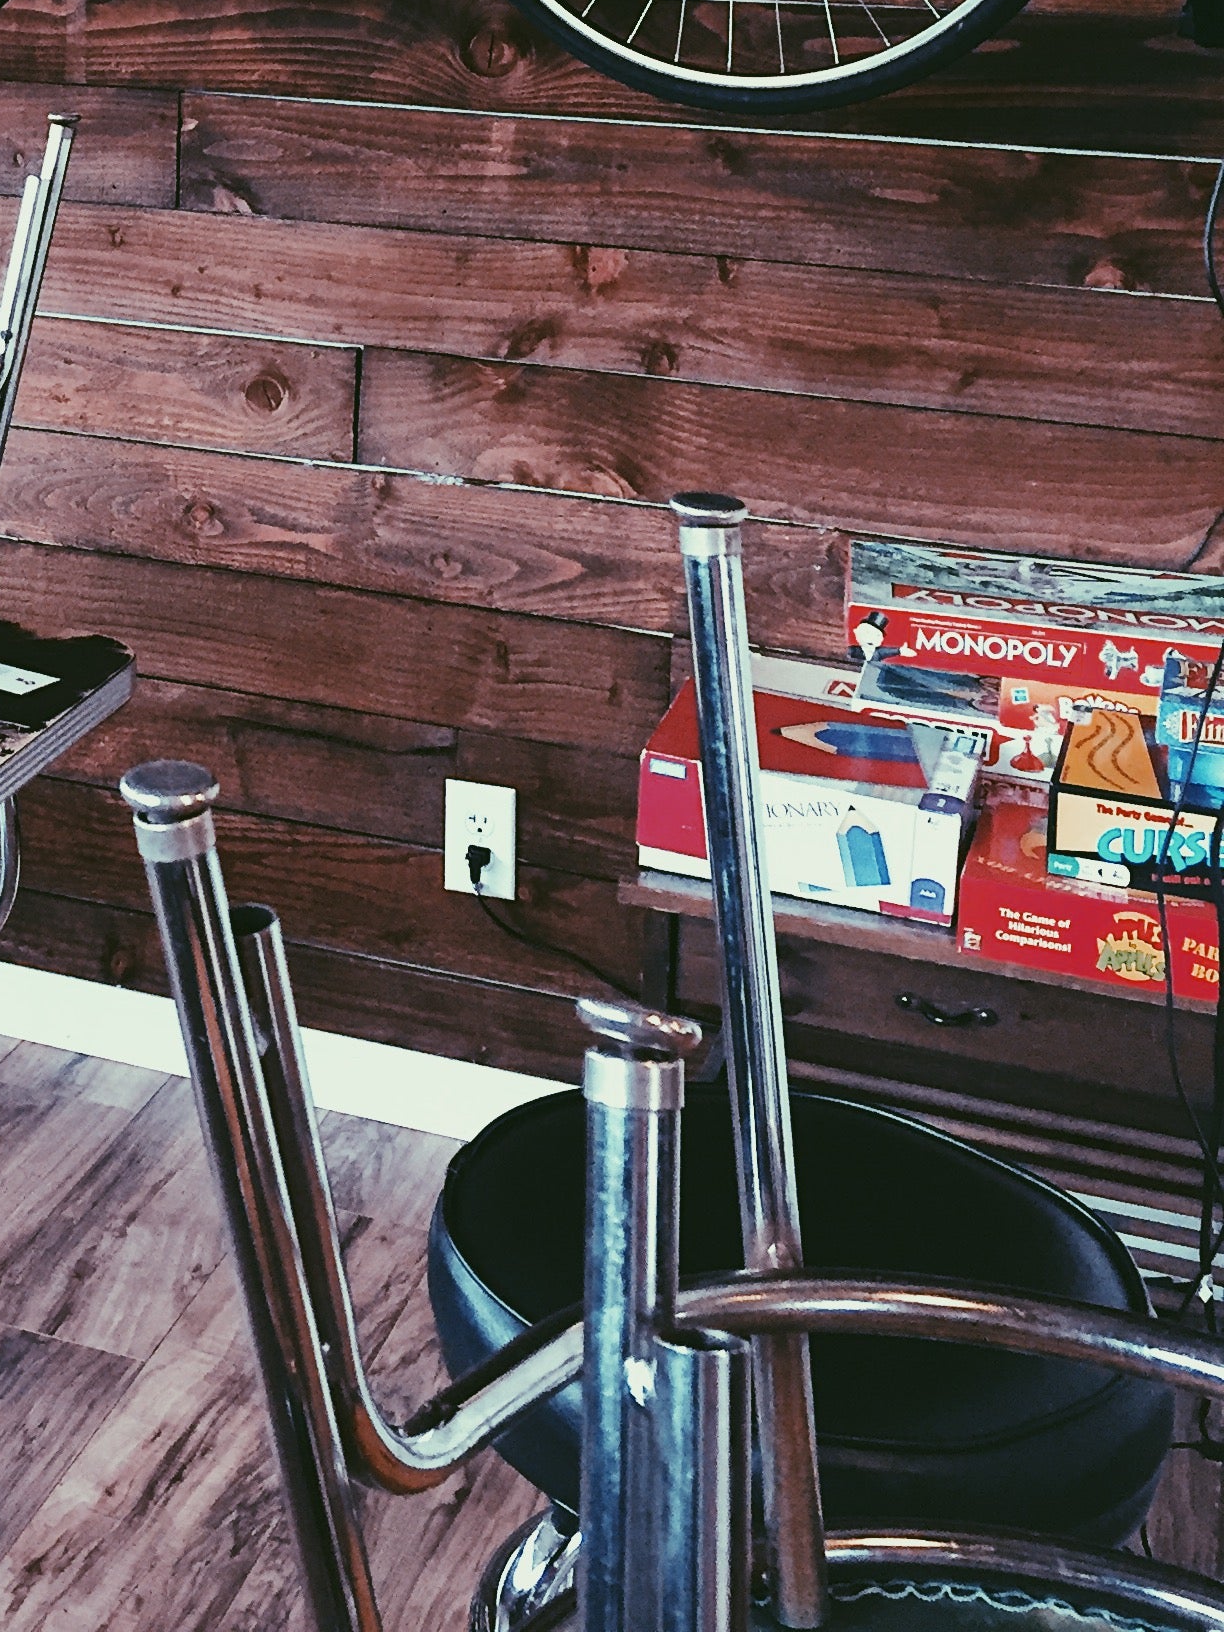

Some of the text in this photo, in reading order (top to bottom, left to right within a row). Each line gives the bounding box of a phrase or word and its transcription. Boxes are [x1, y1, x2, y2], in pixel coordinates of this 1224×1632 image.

[905, 589, 1224, 634] MONOPOLY
[915, 627, 1079, 668] MONOPOLY
[766, 801, 841, 819] IONARY
[1096, 803, 1114, 816] The
[1116, 806, 1142, 820] Party
[998, 907, 1071, 929] The Game of
[1008, 921, 1060, 938] Hilarious
[995, 930, 1073, 953] Comparisons!
[1181, 936, 1219, 961] PAR
[1191, 963, 1219, 983] BO
